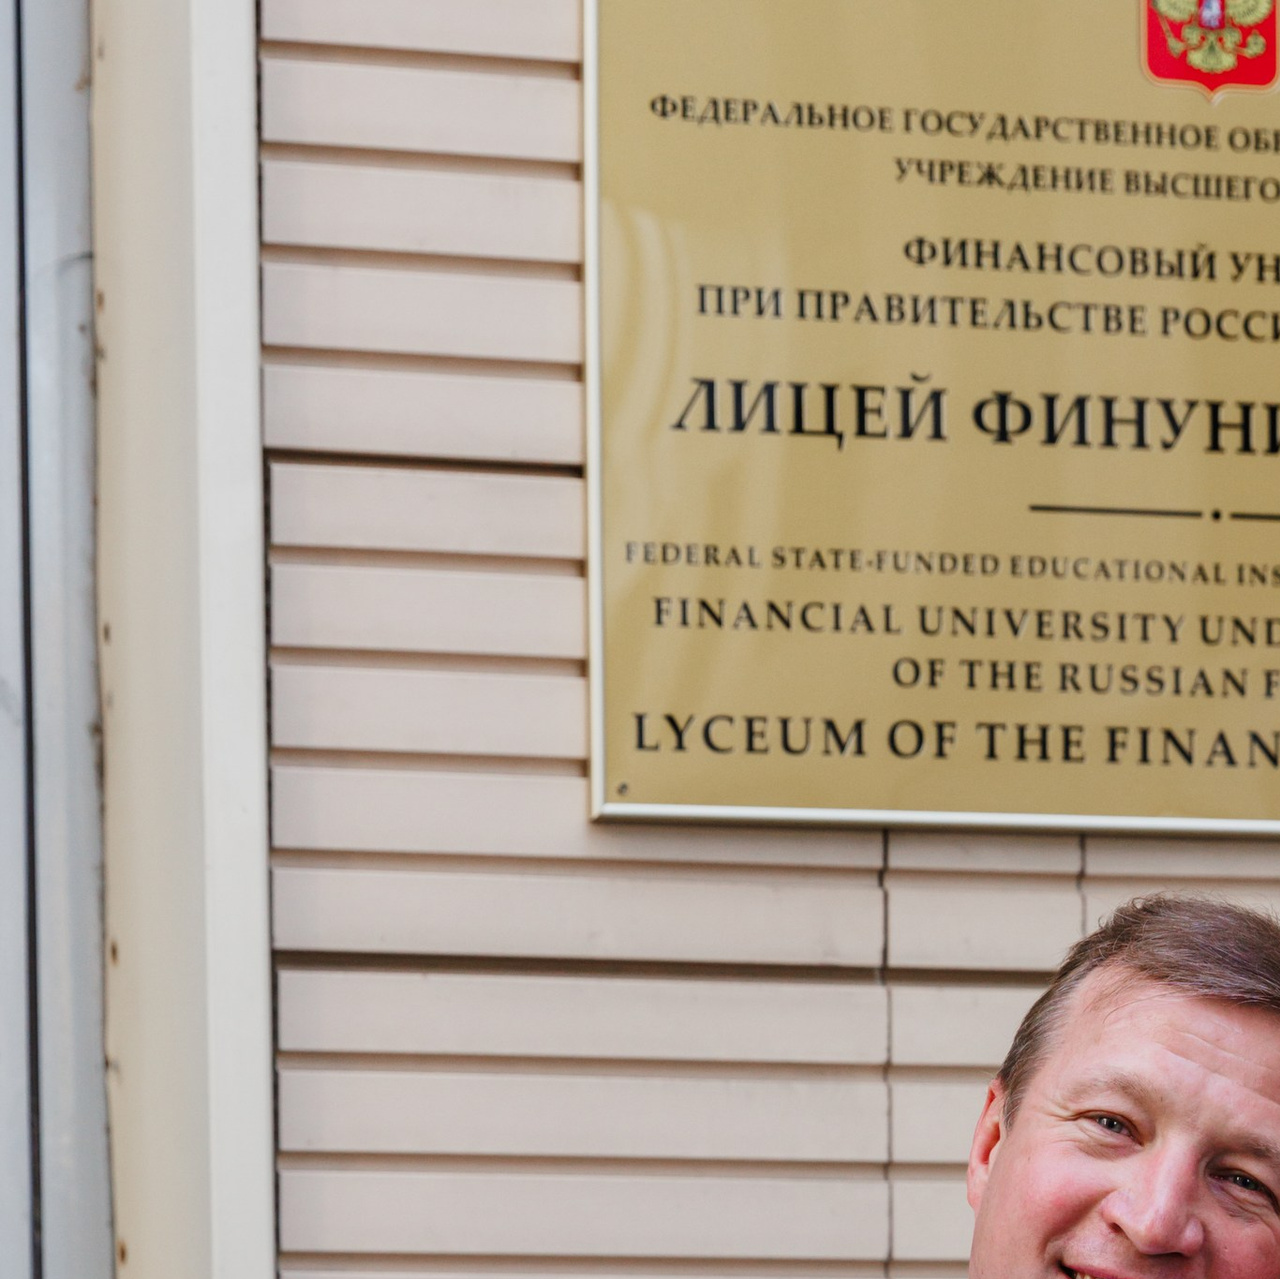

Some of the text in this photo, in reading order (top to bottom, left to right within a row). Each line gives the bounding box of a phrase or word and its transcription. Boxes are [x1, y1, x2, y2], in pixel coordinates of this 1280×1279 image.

[649, 94, 892, 132] ФЕДЕРАЛЬНОЕ
[902, 109, 1220, 150] ГОСУДАРСТВЕННОЕ
[894, 158, 1114, 194] УЧРЕЖДЕНИЕ
[902, 236, 1218, 281] ФИНАНСОВЫЙ
[697, 285, 783, 317] ПРИ
[796, 289, 1147, 335] ПРАВИТЕЛЬСТВЕ
[671, 373, 948, 450] ЛИЦЕЙ
[625, 542, 761, 567] FEDERAL
[771, 546, 1002, 576] STATE-FUNDED
[1009, 555, 1228, 585] EDUCATIONAL
[653, 597, 902, 634] FINANCIAL
[918, 606, 1184, 643] UNIVERSITY
[891, 658, 946, 688] OF
[958, 660, 1044, 692] THE
[1058, 663, 1249, 698] RUSSIAN
[634, 713, 867, 756] LYCEUM
[886, 720, 958, 759] OF
[975, 722, 1086, 763] THE
